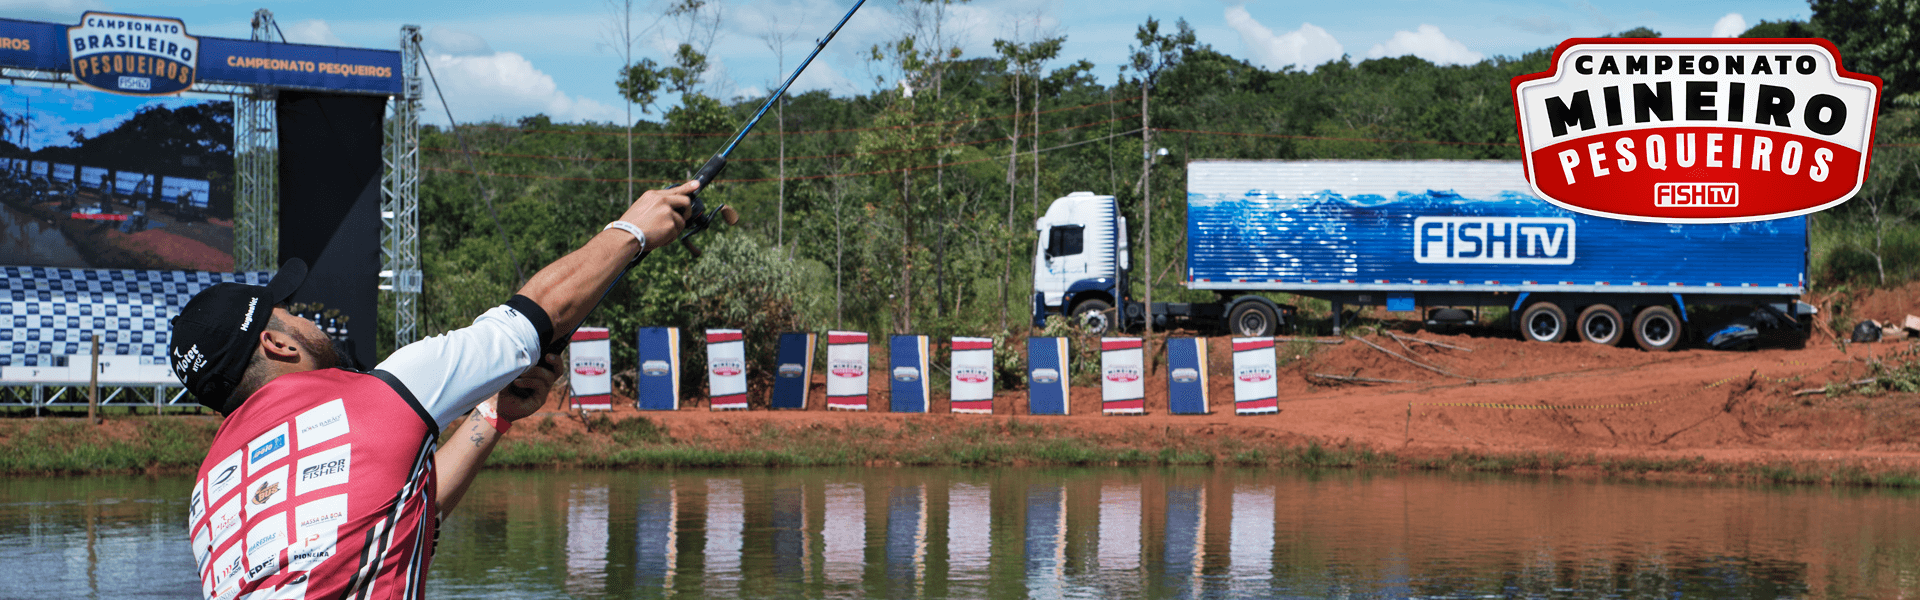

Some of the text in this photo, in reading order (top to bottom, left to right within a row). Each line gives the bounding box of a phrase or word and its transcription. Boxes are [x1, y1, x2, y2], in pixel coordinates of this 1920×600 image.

[88, 18, 178, 34] CAMPEONATO
[74, 34, 192, 61] BRASILEIRO
[78, 55, 189, 84] PESQUEIROS
[227, 55, 392, 77] CAMPEONATO PESQUEIROS
[320, 458, 346, 470] FOR
[302, 465, 345, 481] FISHER
[301, 517, 320, 527] MASSA
